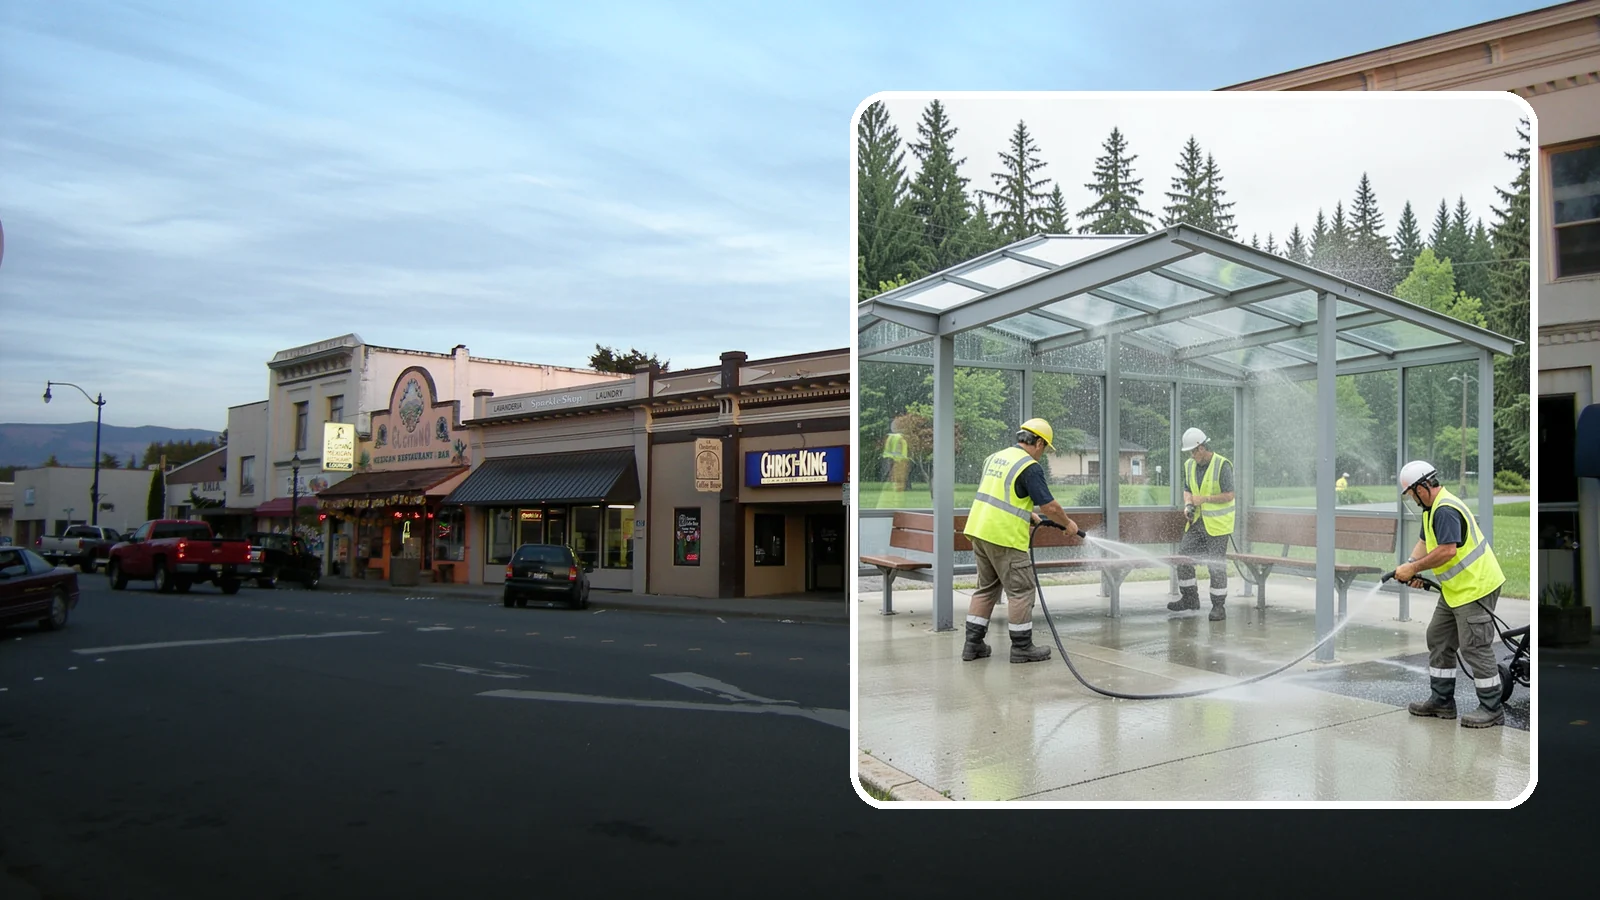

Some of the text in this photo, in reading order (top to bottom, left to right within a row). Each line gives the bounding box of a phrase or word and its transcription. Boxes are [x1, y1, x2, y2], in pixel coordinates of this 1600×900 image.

[493, 389, 623, 412] LAVANDERIA Sparkle Shop LAUNDRY
[397, 451, 433, 462] RESTAURANT
[438, 450, 449, 459] BAR
[761, 450, 827, 478] CHRIST KING
